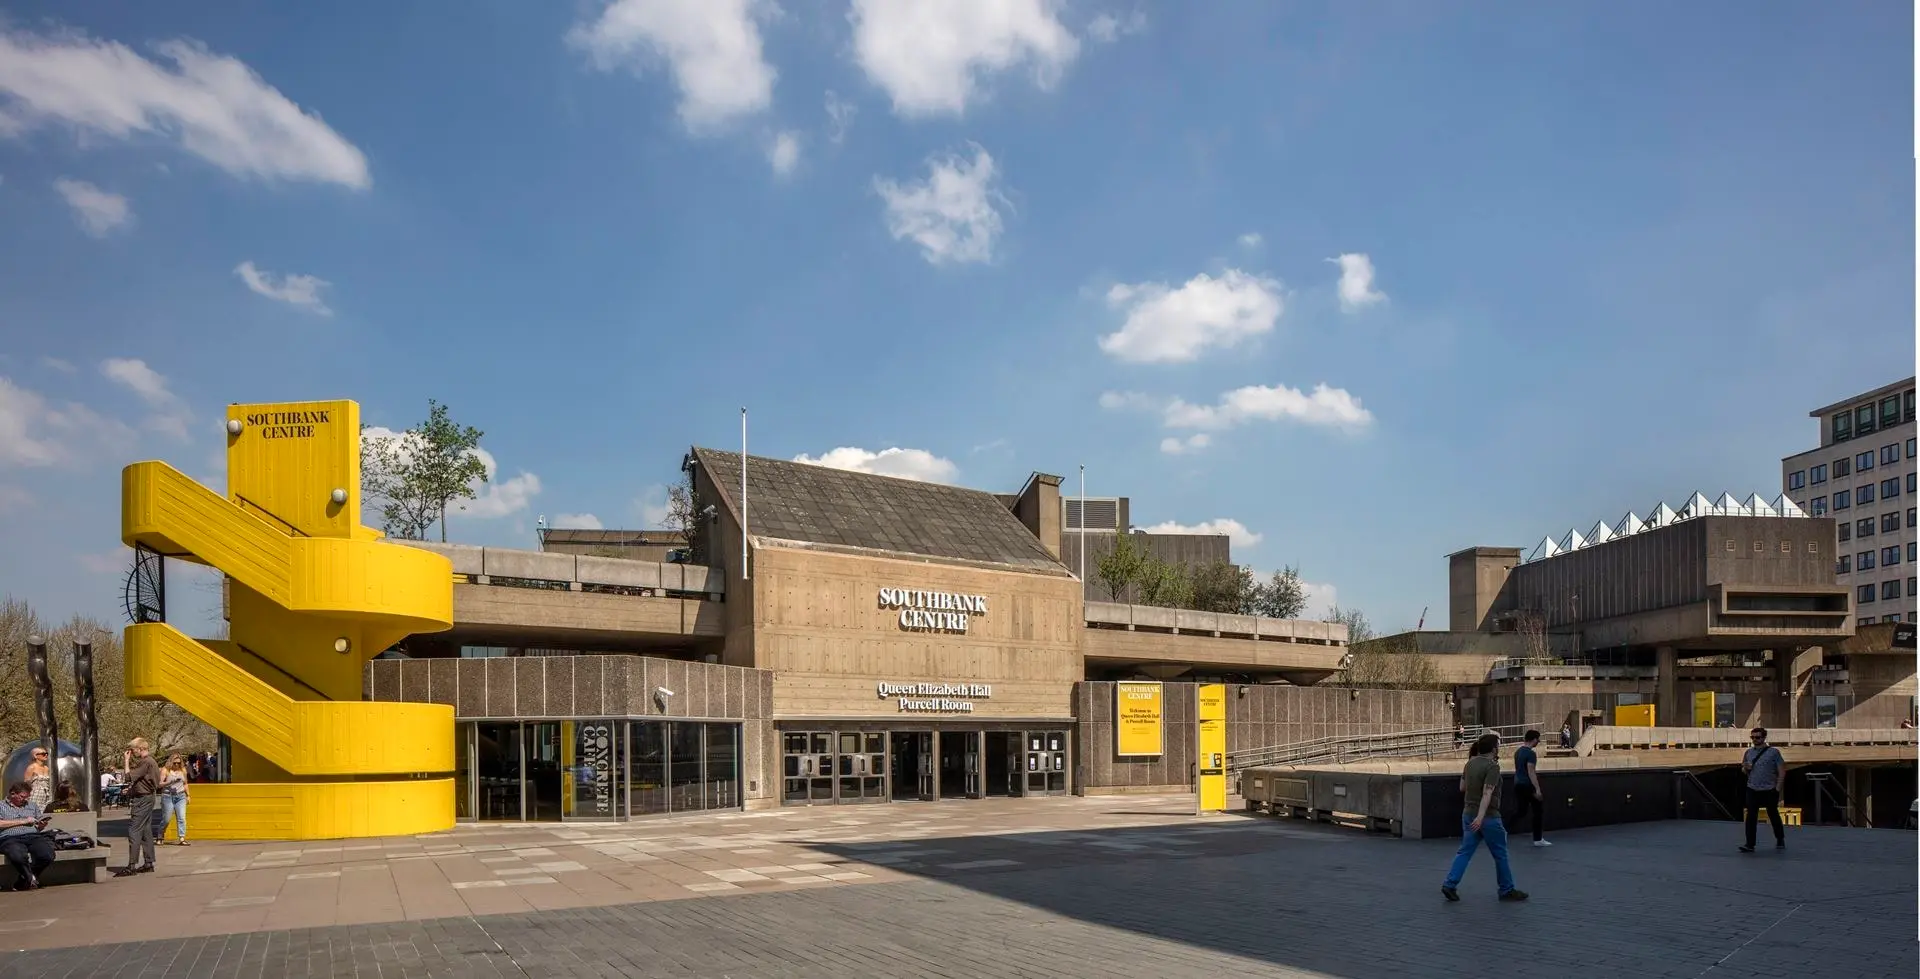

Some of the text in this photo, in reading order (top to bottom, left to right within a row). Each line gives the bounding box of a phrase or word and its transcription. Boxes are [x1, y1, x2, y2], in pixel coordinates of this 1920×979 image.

[247, 411, 329, 426] SOUTHBANK
[262, 425, 315, 439] CENTRE
[879, 587, 987, 612] SOUTHBANK
[900, 609, 969, 630] CENTRE
[878, 681, 991, 696] Queen Elizabeth Hall
[1120, 685, 1160, 693] SOUTHBANK
[899, 698, 973, 711] Purcell Room
[596, 725, 609, 812] CONCRETE
